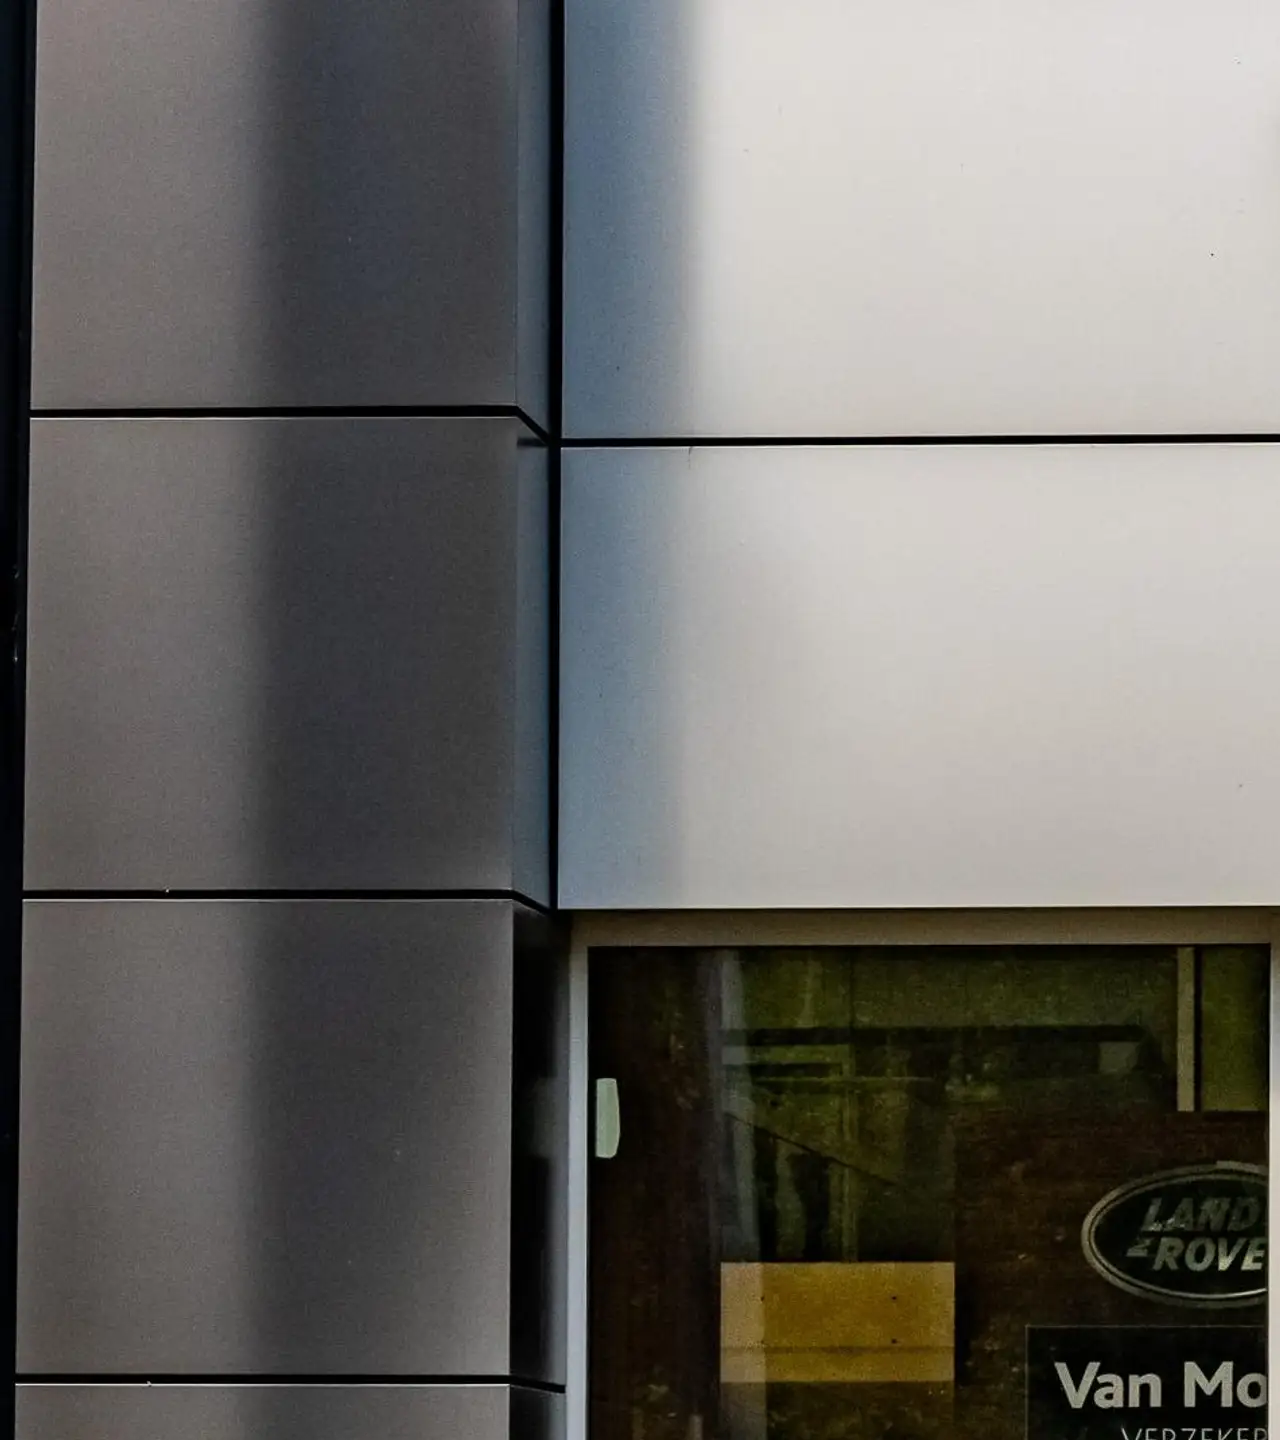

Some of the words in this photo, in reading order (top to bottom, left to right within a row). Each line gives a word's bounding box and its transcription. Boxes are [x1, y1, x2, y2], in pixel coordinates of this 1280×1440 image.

[1140, 1197, 1261, 1232] LAND
[1152, 1236, 1267, 1272] ROVE
[1054, 1361, 1162, 1409] Van
